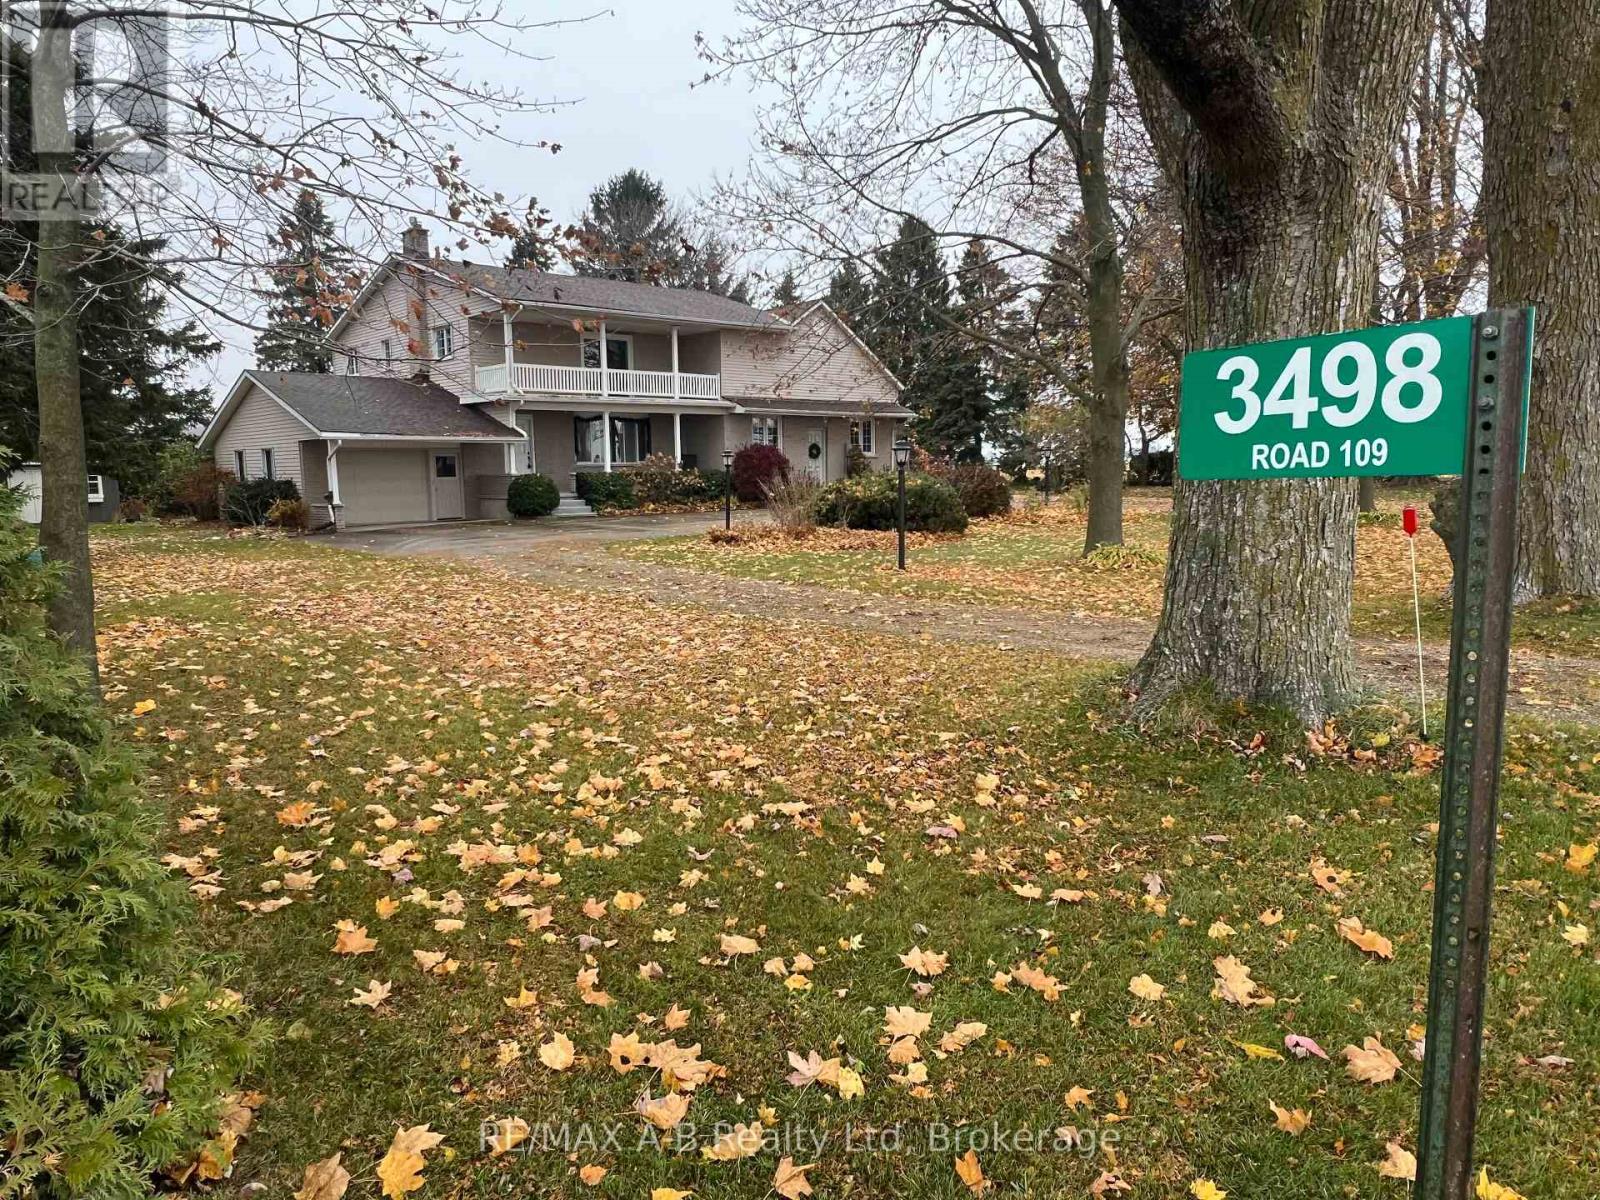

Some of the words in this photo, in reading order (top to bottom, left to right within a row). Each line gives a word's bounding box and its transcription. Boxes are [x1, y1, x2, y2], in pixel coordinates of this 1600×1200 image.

[1214, 333, 1443, 434] 3498
[1252, 441, 1330, 470] ROAD
[1339, 438, 1389, 467] 109
